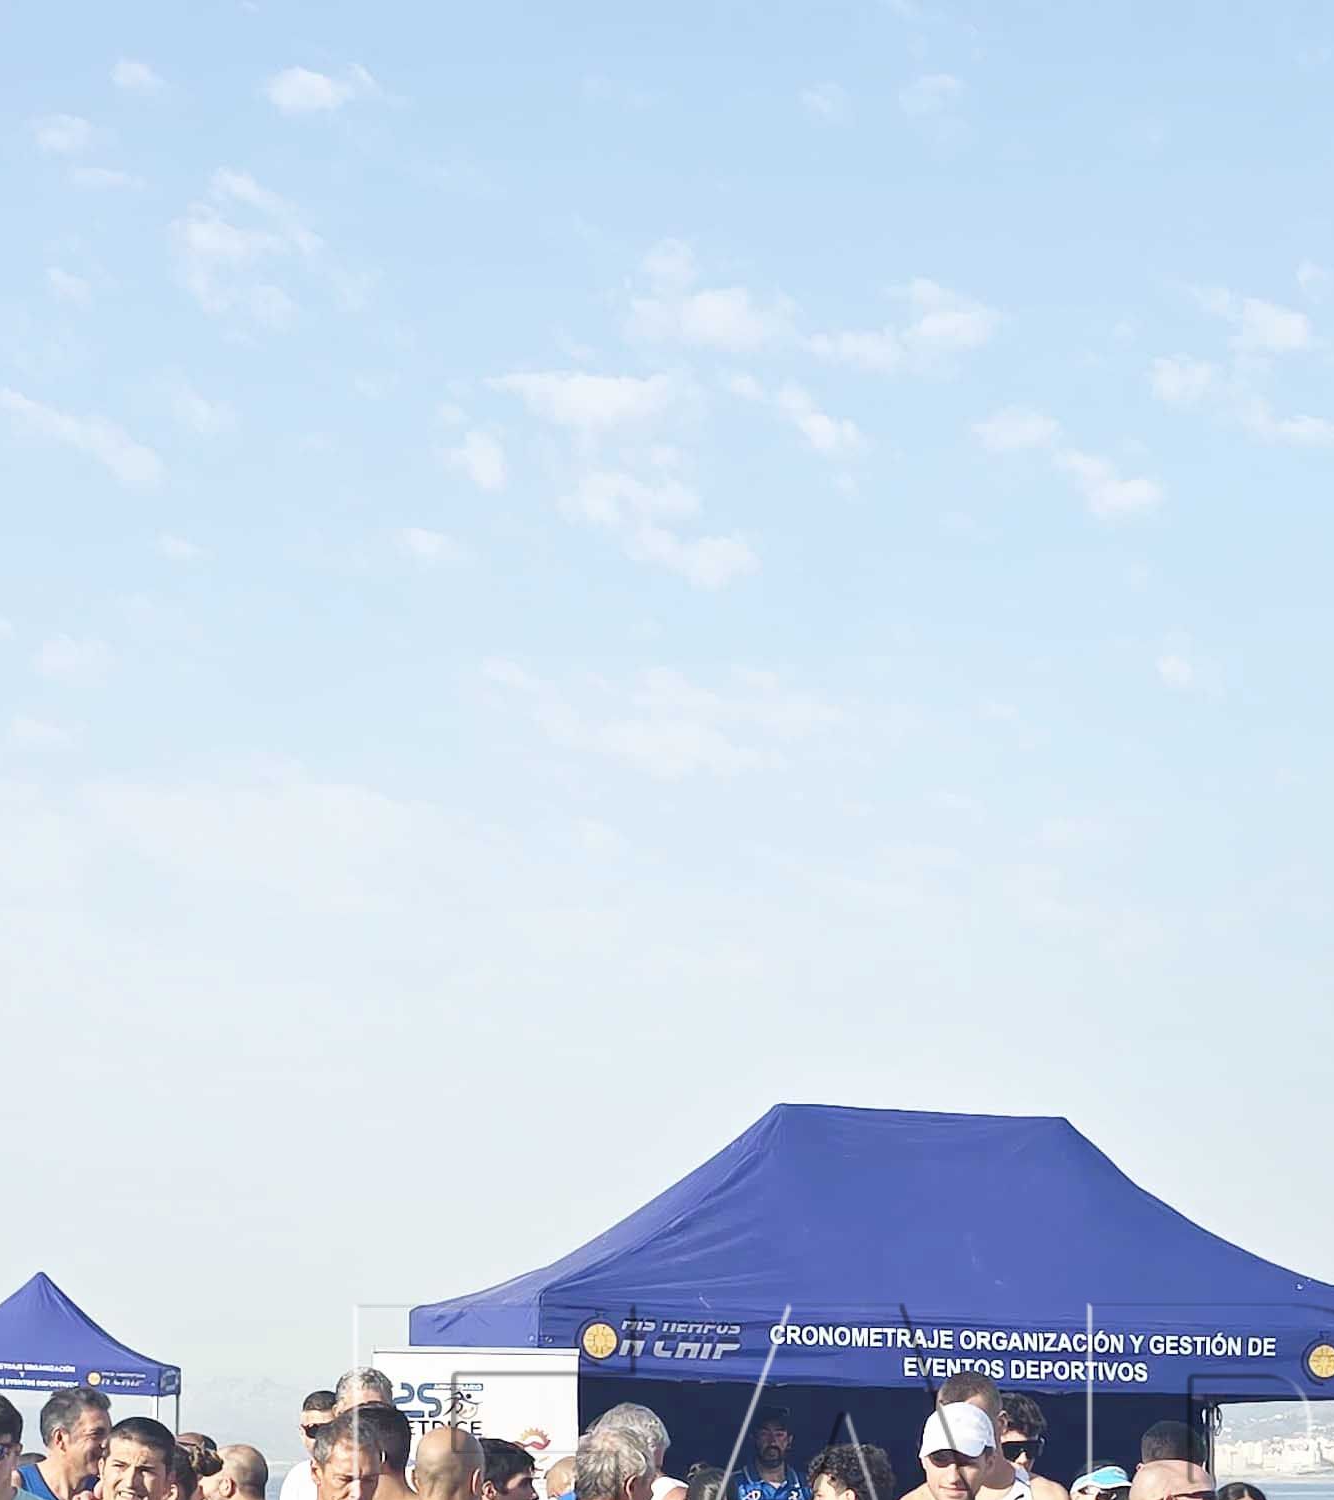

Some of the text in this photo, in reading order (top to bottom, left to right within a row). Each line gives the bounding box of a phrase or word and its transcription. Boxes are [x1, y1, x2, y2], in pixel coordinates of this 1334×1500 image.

[652, 1337, 742, 1361] CHIP
[769, 1324, 1277, 1358] CRONOMETRAJE ORGANIZACIÓN Y GESTIÓN DE
[903, 1357, 1149, 1382] EVENTOS DEPORTIVOS
